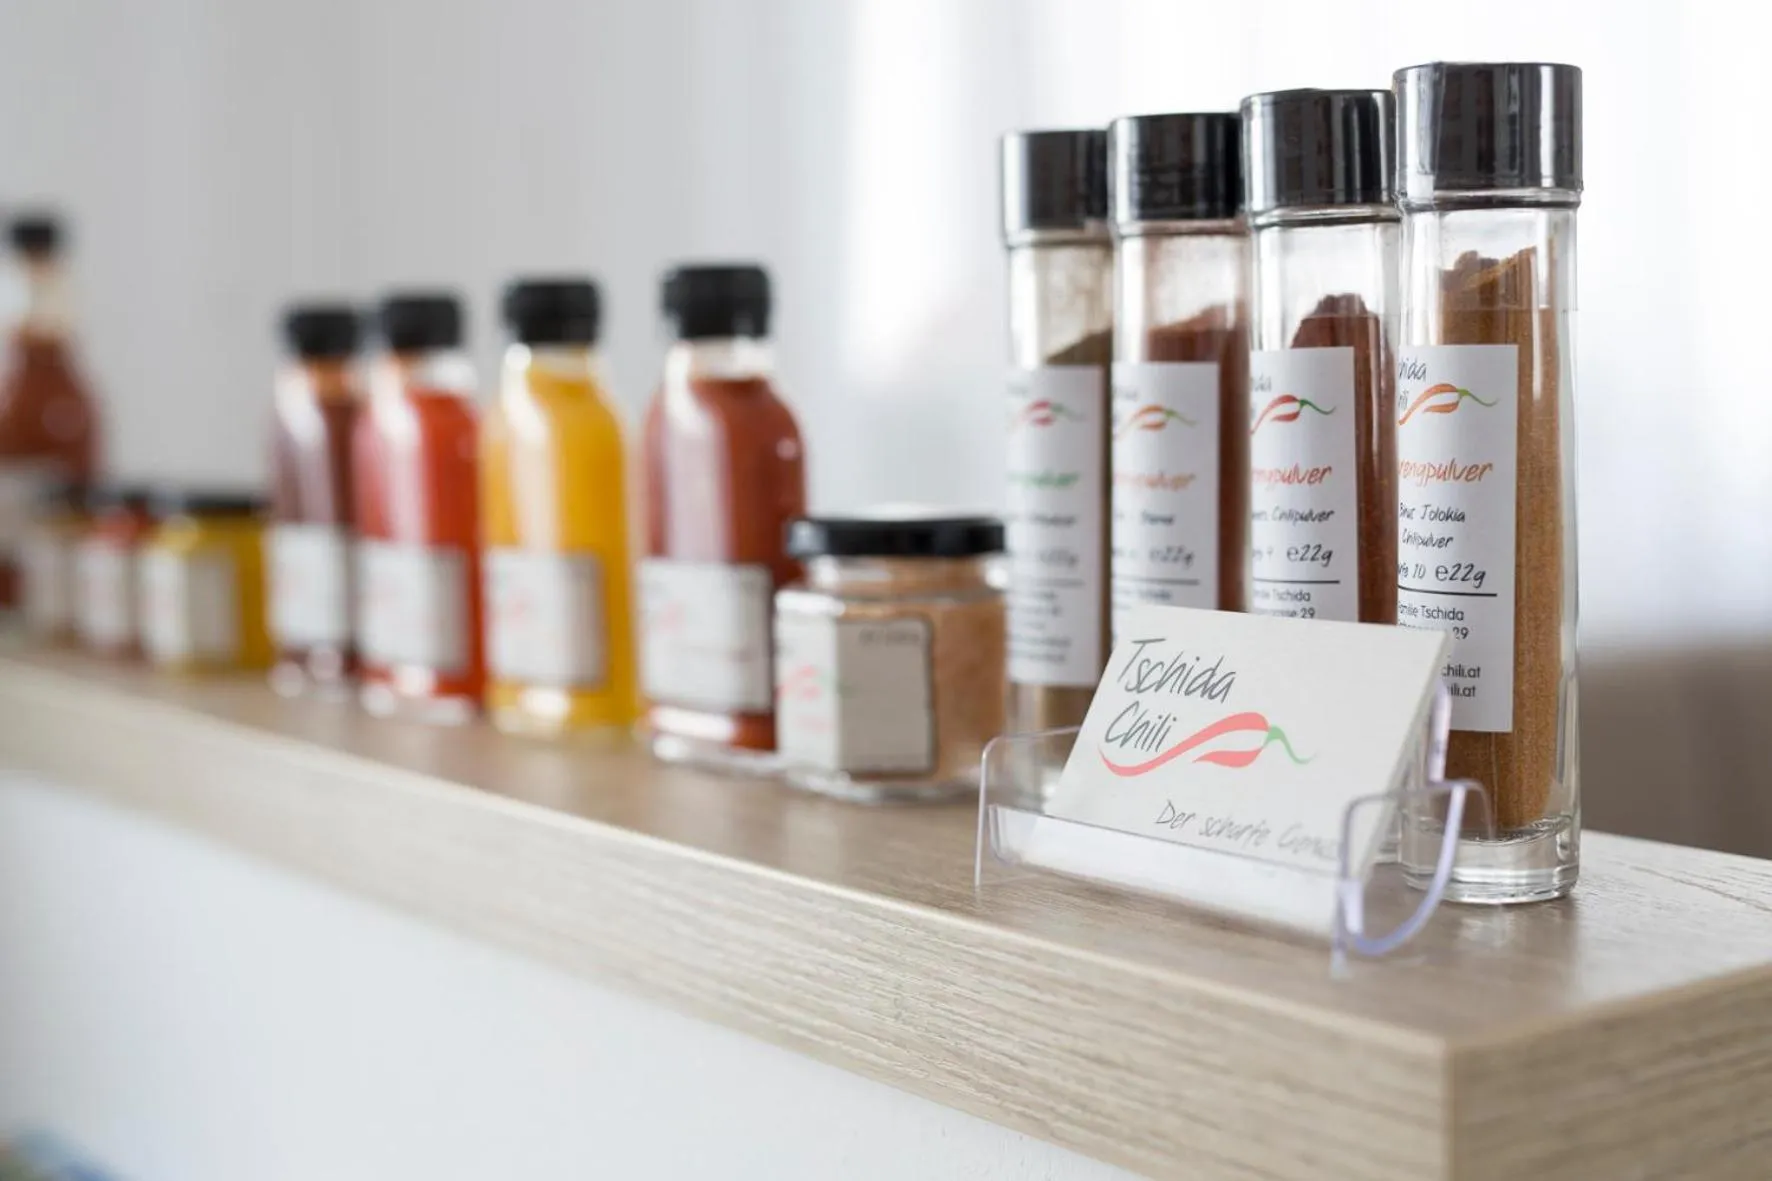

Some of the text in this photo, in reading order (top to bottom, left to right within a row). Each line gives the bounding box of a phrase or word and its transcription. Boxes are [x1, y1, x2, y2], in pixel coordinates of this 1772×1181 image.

[1420, 503, 1466, 523] Jolokia
[1300, 606, 1317, 620] 29
[1420, 604, 1466, 622] Tschida
[1116, 636, 1237, 704] Tschida
[1104, 700, 1178, 753] Chili
[1155, 799, 1197, 831] Der
